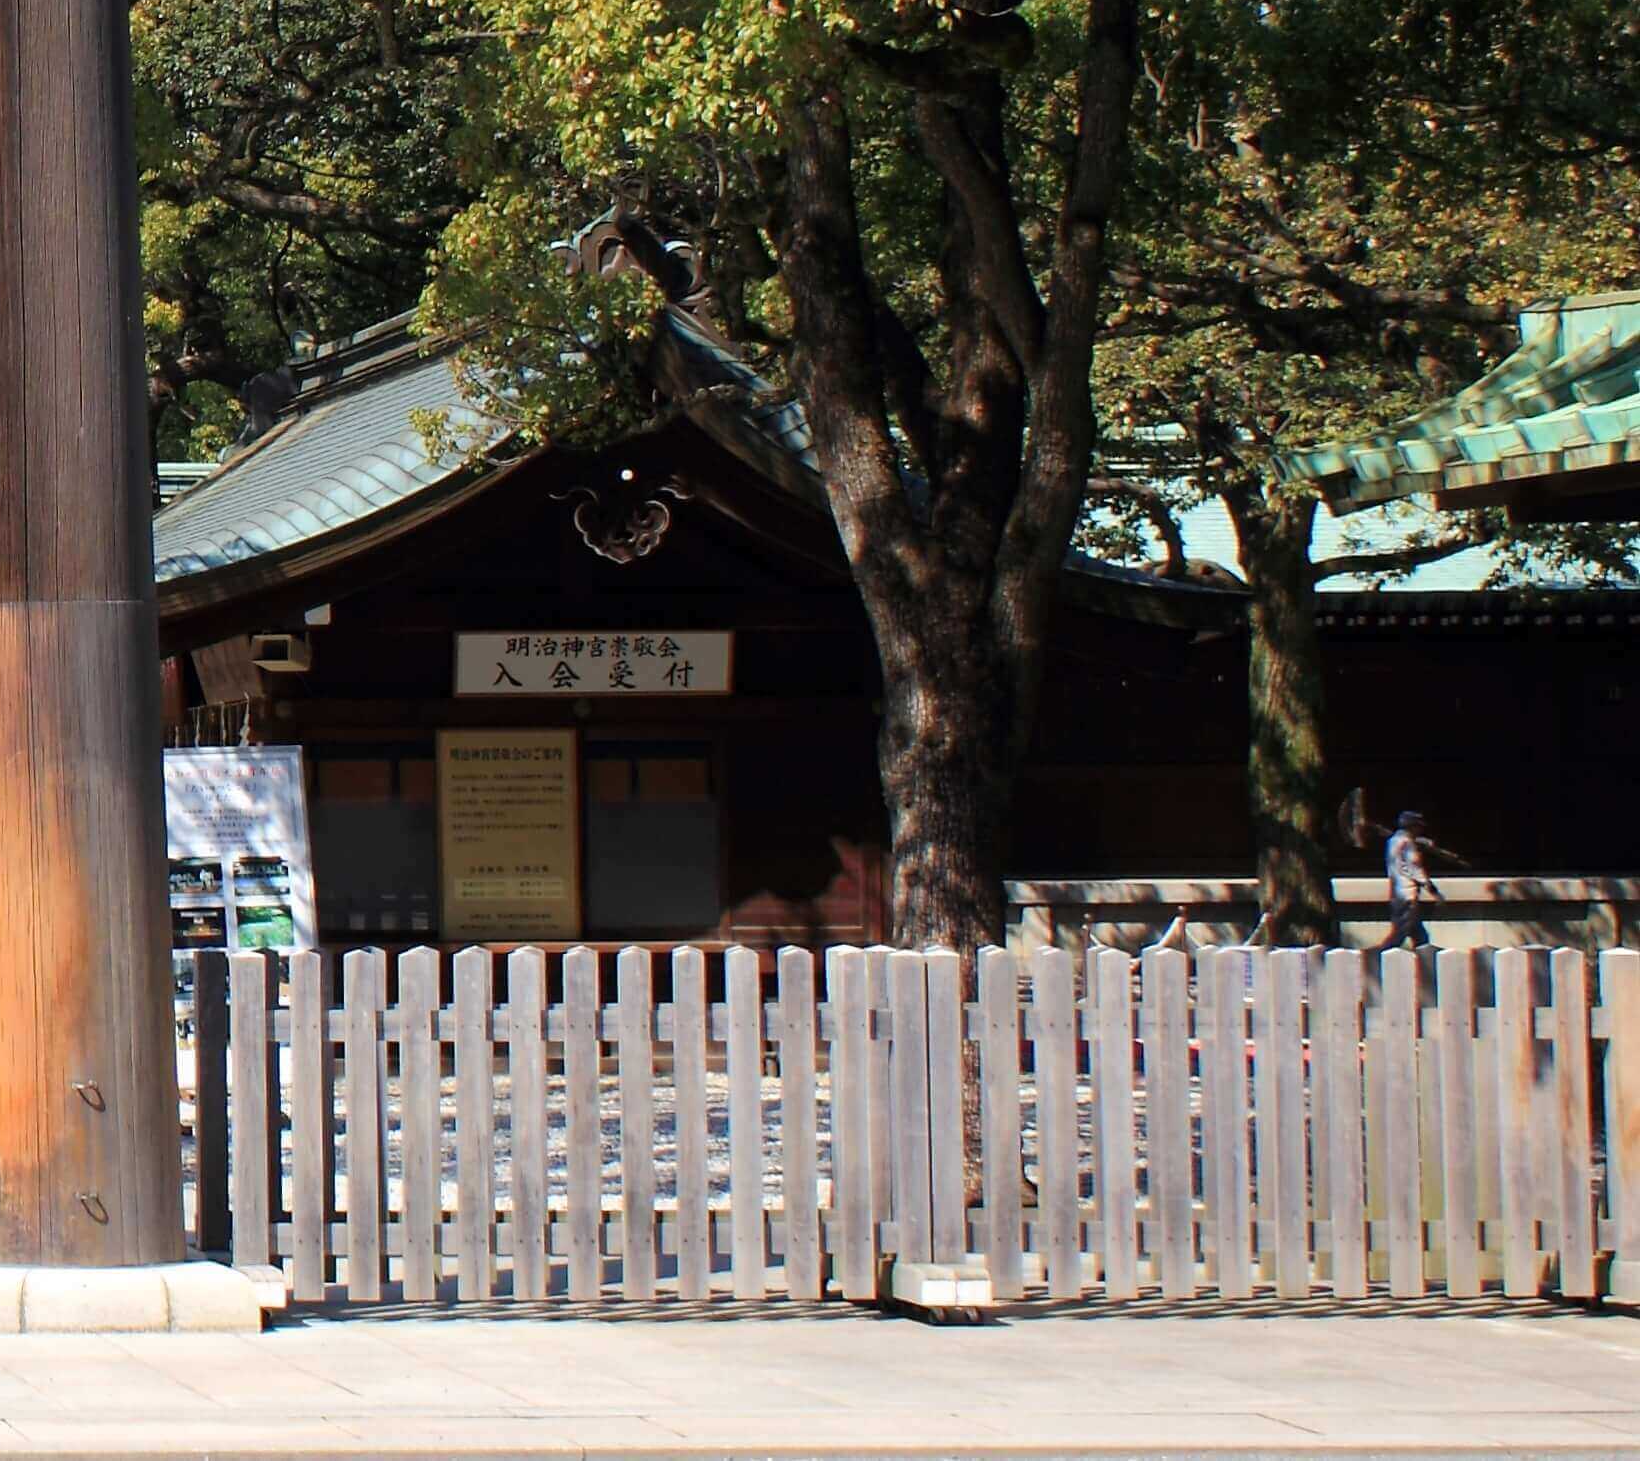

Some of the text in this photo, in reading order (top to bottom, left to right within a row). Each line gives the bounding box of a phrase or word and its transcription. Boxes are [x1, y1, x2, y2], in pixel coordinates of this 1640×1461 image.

[505, 636, 680, 658] 明治神宮崇敬会
[493, 661, 693, 688] 入会受付
